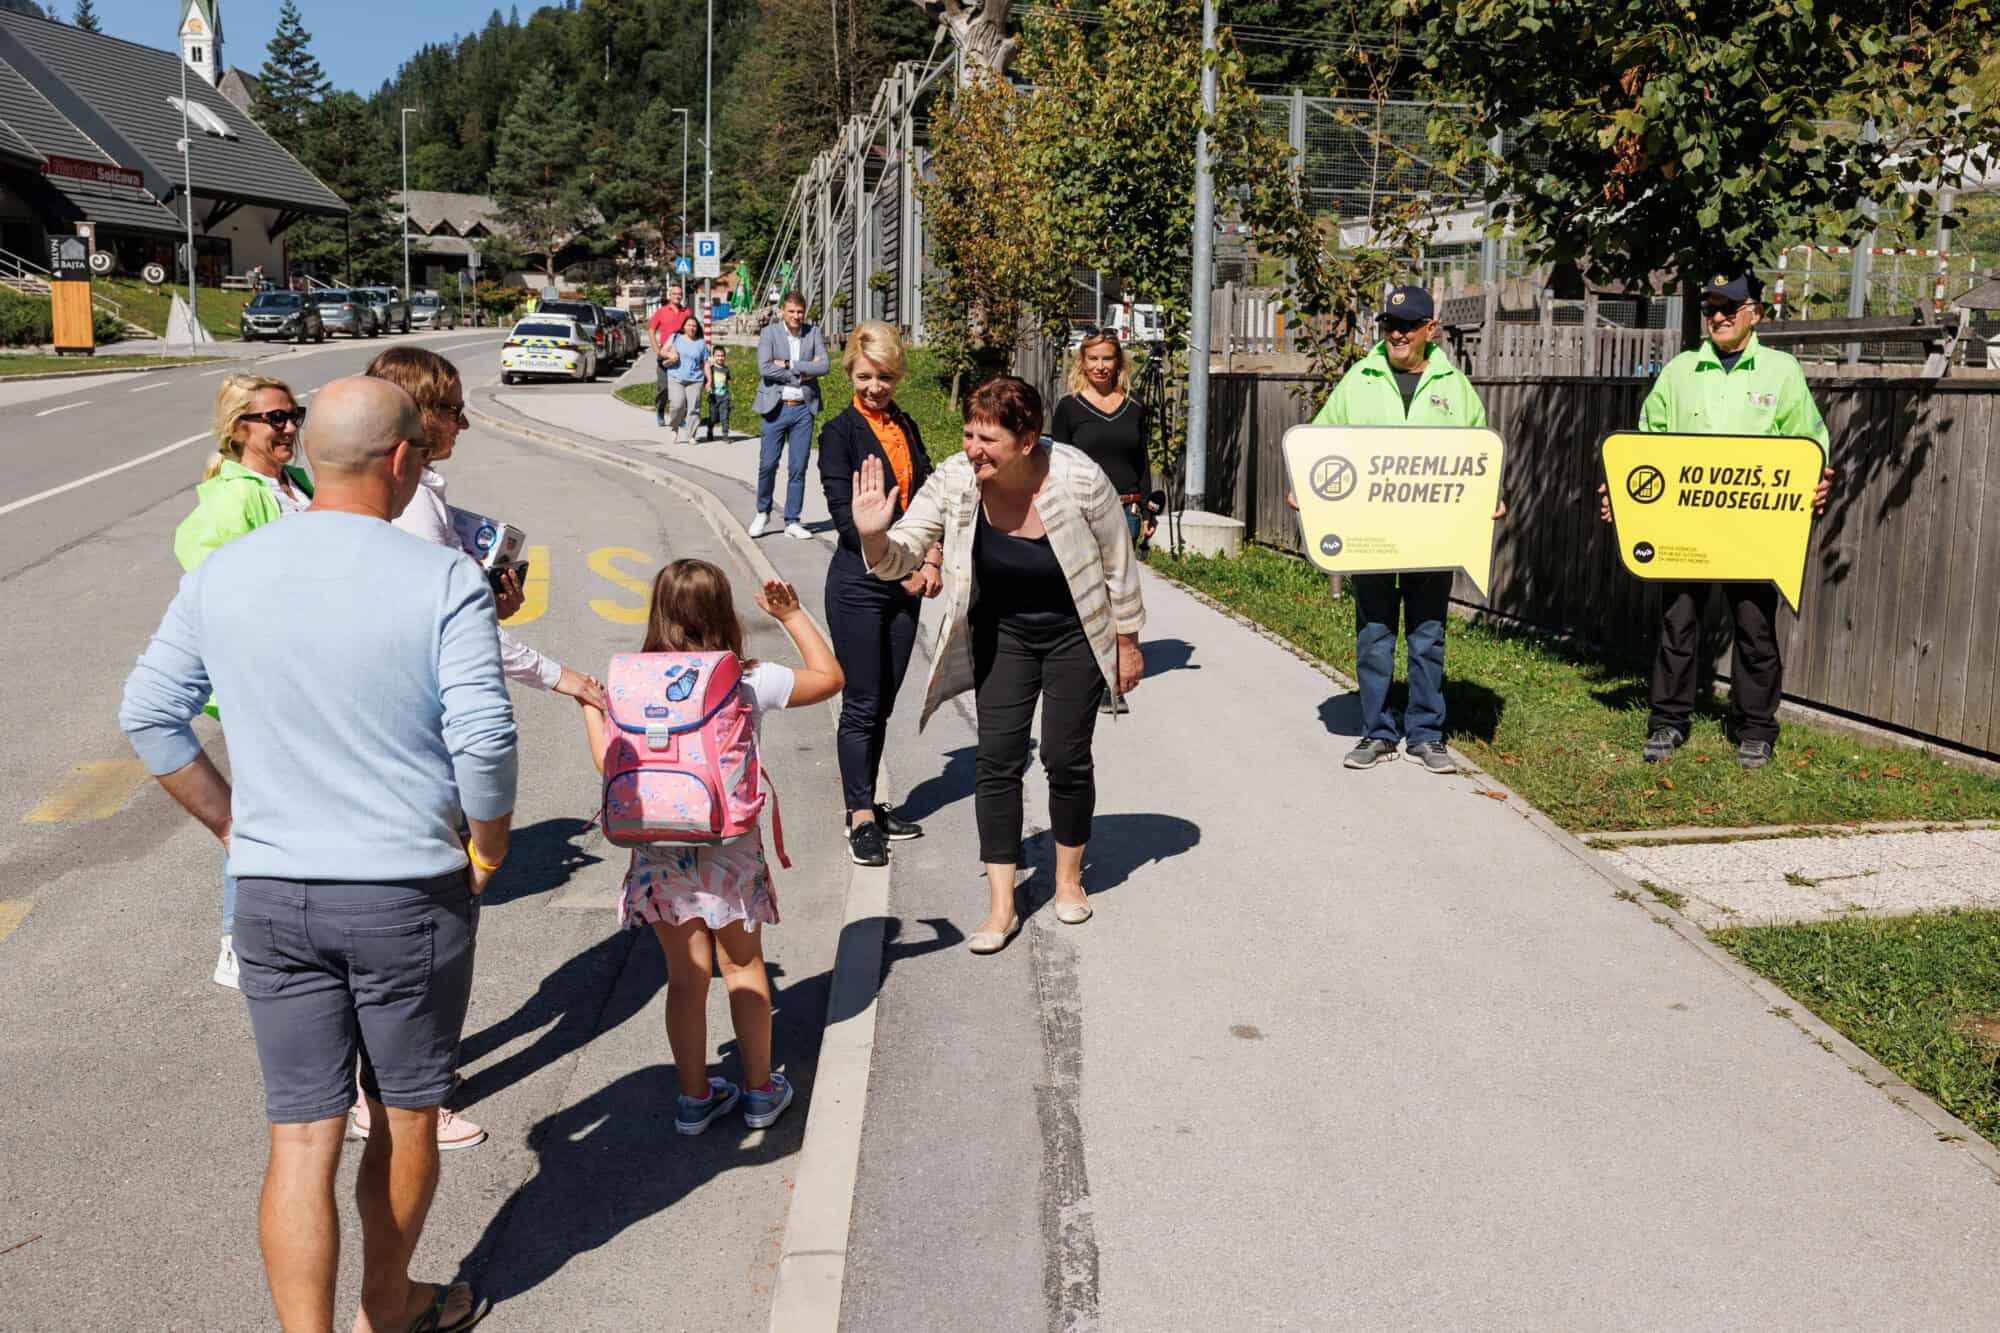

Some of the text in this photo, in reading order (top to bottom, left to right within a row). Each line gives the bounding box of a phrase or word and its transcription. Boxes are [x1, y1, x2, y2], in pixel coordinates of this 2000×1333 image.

[1367, 452, 1488, 477] SPREMLJAŠ
[1679, 465, 1790, 488] KO VOZIŠ, SI
[1367, 482, 1465, 503] PROMET?
[1678, 489, 1805, 512] NEDOSEGLJIV.
